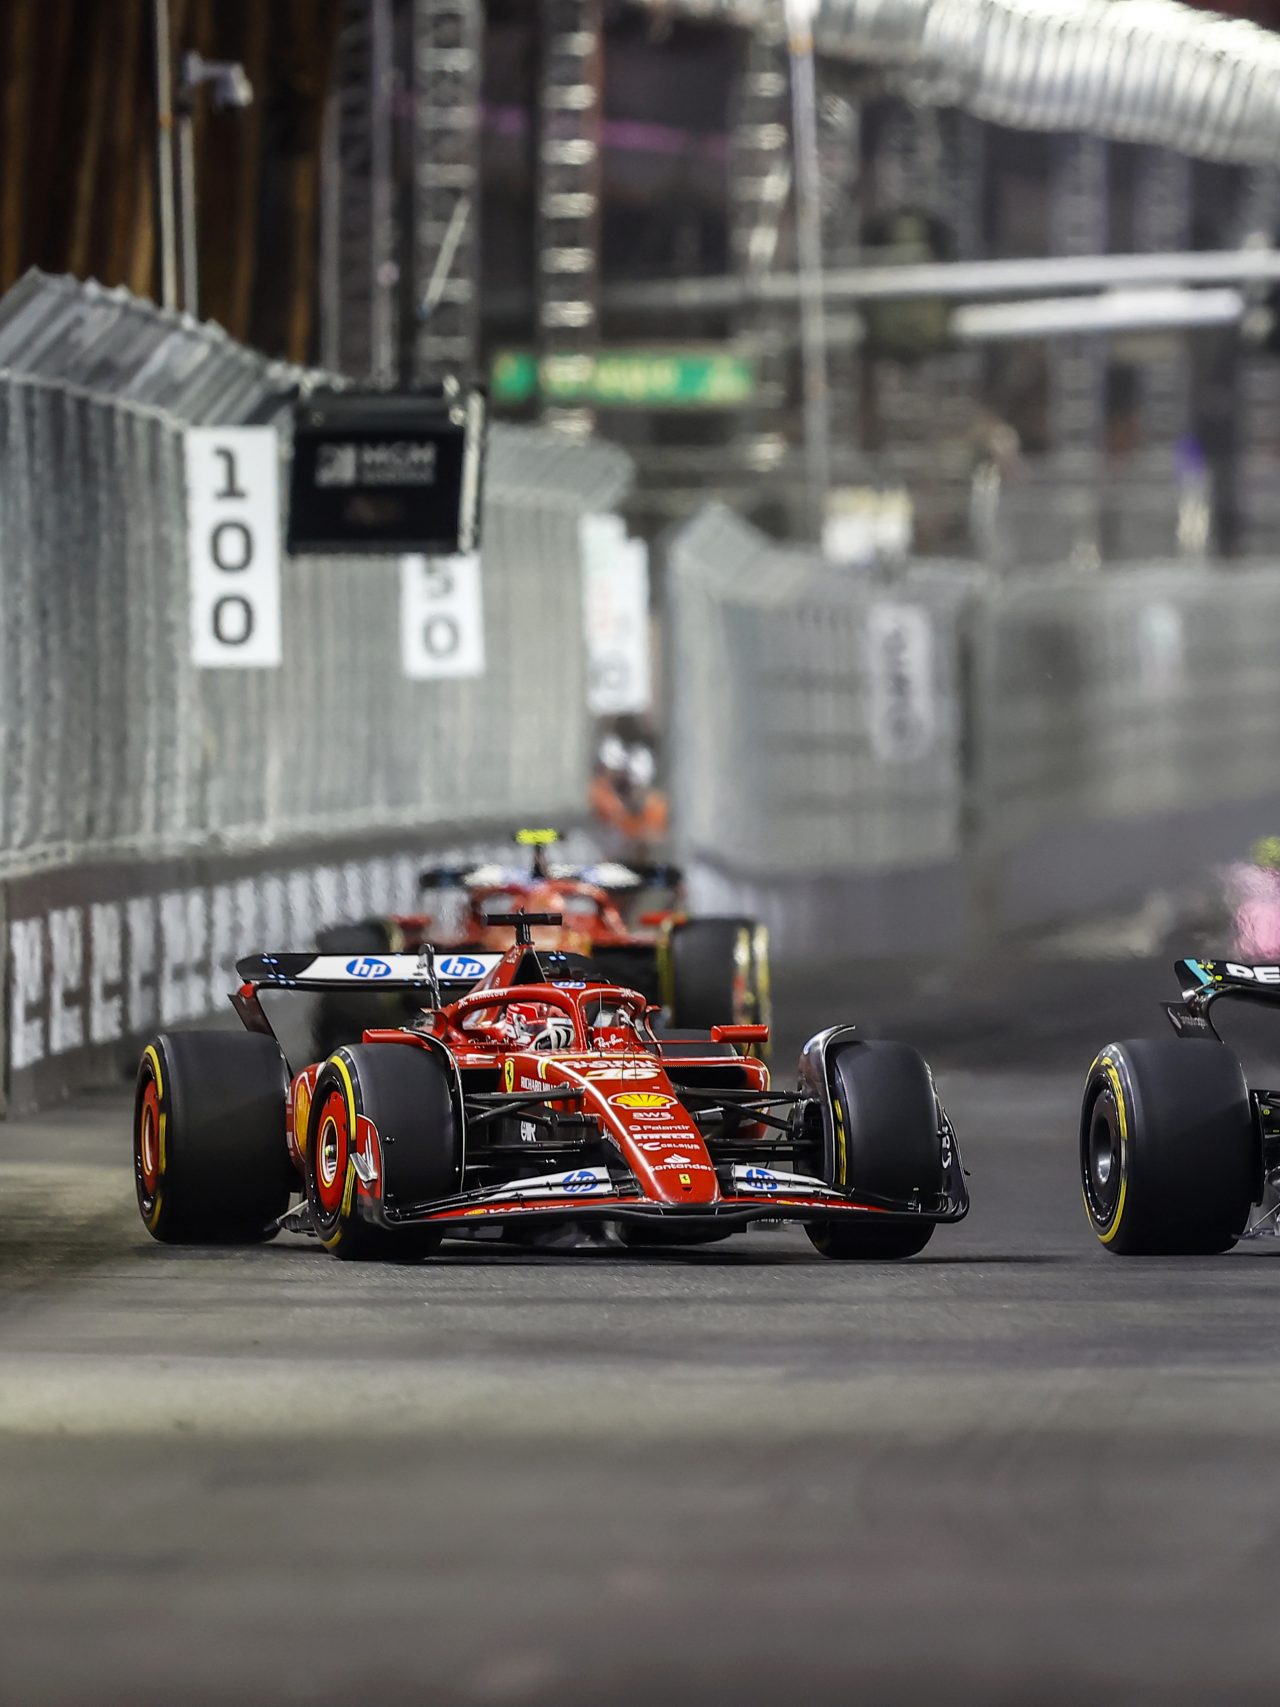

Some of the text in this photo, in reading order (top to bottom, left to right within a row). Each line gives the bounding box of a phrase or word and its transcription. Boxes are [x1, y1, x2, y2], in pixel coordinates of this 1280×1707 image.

[362, 441, 436, 463] MGM
[212, 447, 253, 645] 100
[350, 957, 387, 978] hp
[445, 957, 483, 977] hp
[583, 1069, 661, 1080] 16
[650, 1163, 714, 1171] Santander
